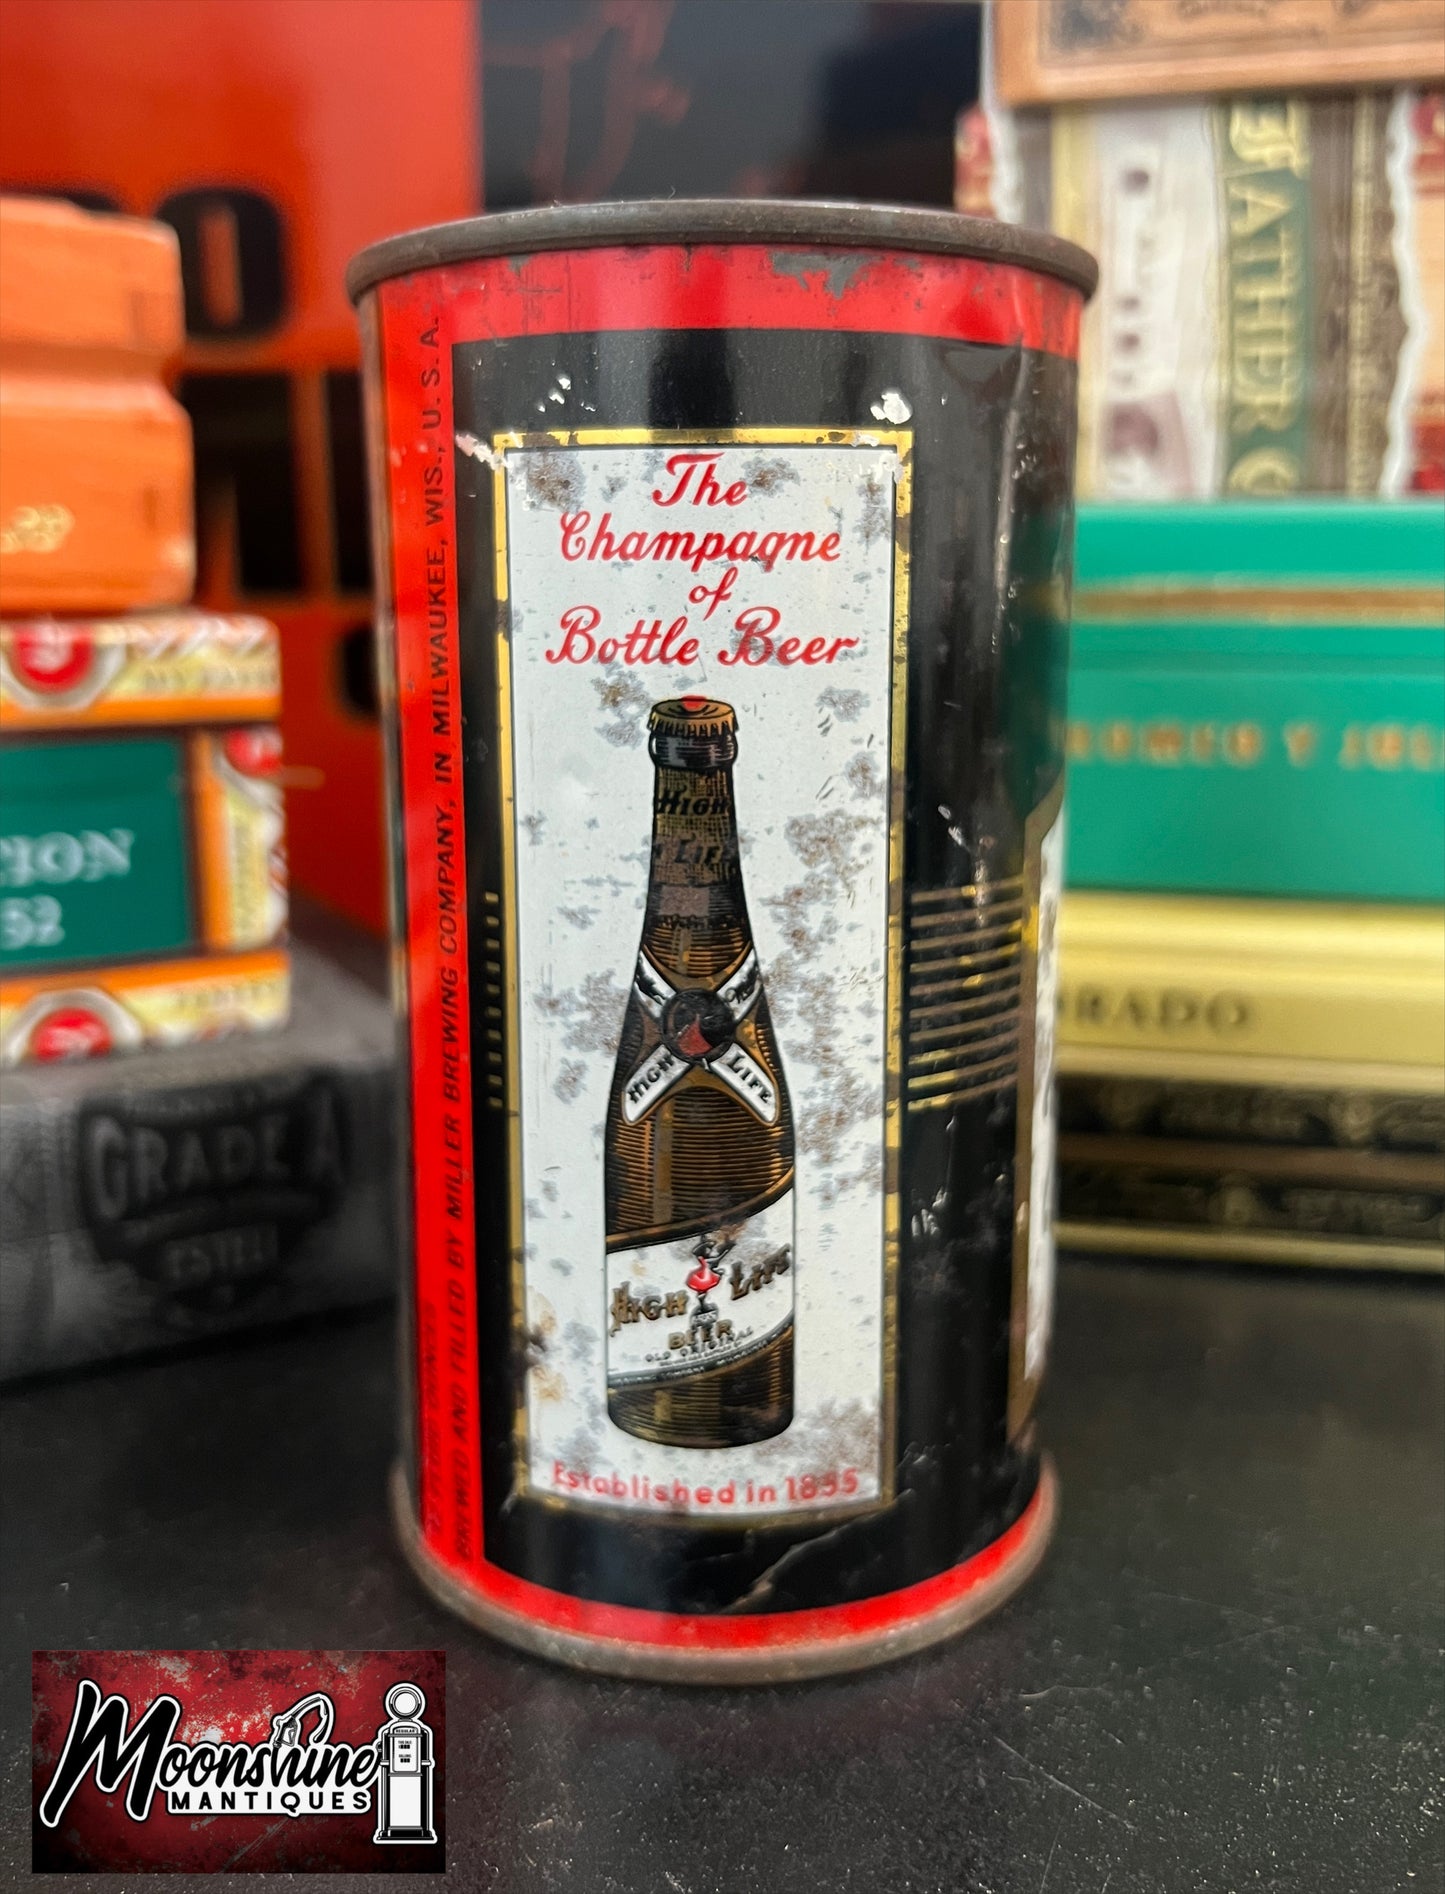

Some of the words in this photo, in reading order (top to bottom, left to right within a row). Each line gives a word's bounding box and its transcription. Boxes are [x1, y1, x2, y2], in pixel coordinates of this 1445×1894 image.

[652, 452, 748, 507] The
[560, 510, 841, 572] Champagne
[688, 566, 739, 621] of
[425, 539, 453, 736] MILWAUKEE,
[545, 604, 700, 665] Bottle
[717, 605, 860, 666] Beer
[433, 751, 453, 784] IN
[436, 800, 457, 956] COMPANY,
[439, 967, 462, 1103] BREWING
[626, 1053, 676, 1105] HIGH
[726, 1050, 773, 1104] LIFE
[443, 1113, 463, 1221] MILLER
[444, 1230, 465, 1271] BY
[446, 1279, 470, 1374] FILLED
[450, 1382, 472, 1443] AND
[552, 1460, 736, 1505] Established
[745, 1479, 778, 1504] in
